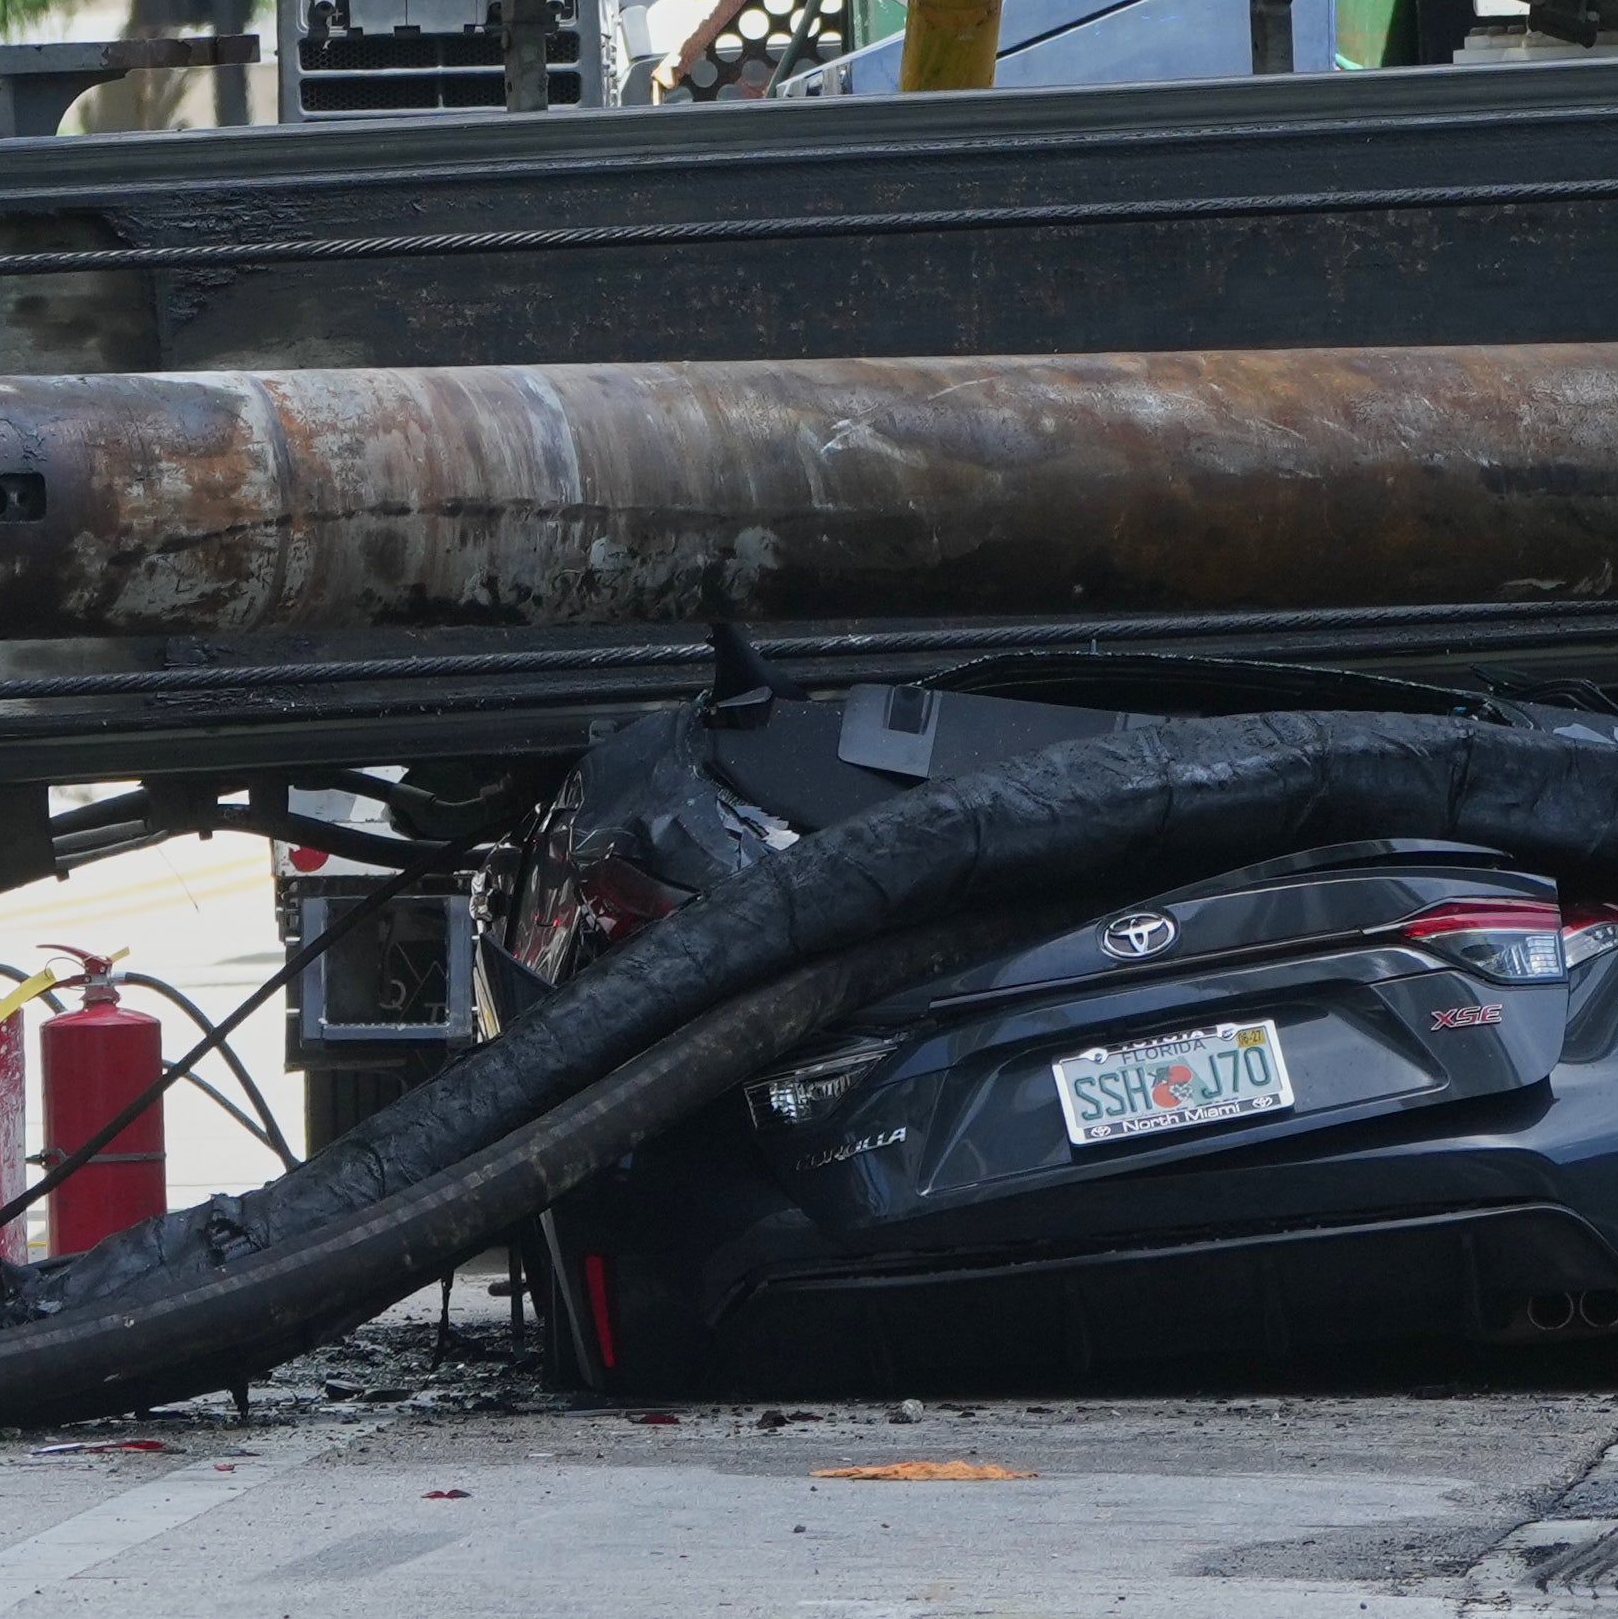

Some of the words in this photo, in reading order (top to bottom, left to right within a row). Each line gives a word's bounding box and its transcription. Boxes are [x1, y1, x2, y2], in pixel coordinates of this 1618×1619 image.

[1430, 1004, 1503, 1032] XSE
[1122, 1038, 1207, 1065] FLORIDA
[1073, 1065, 1153, 1121] SSH
[1201, 1046, 1271, 1099] J70
[1122, 1114, 1179, 1133] North
[1184, 1102, 1241, 1122] Miami
